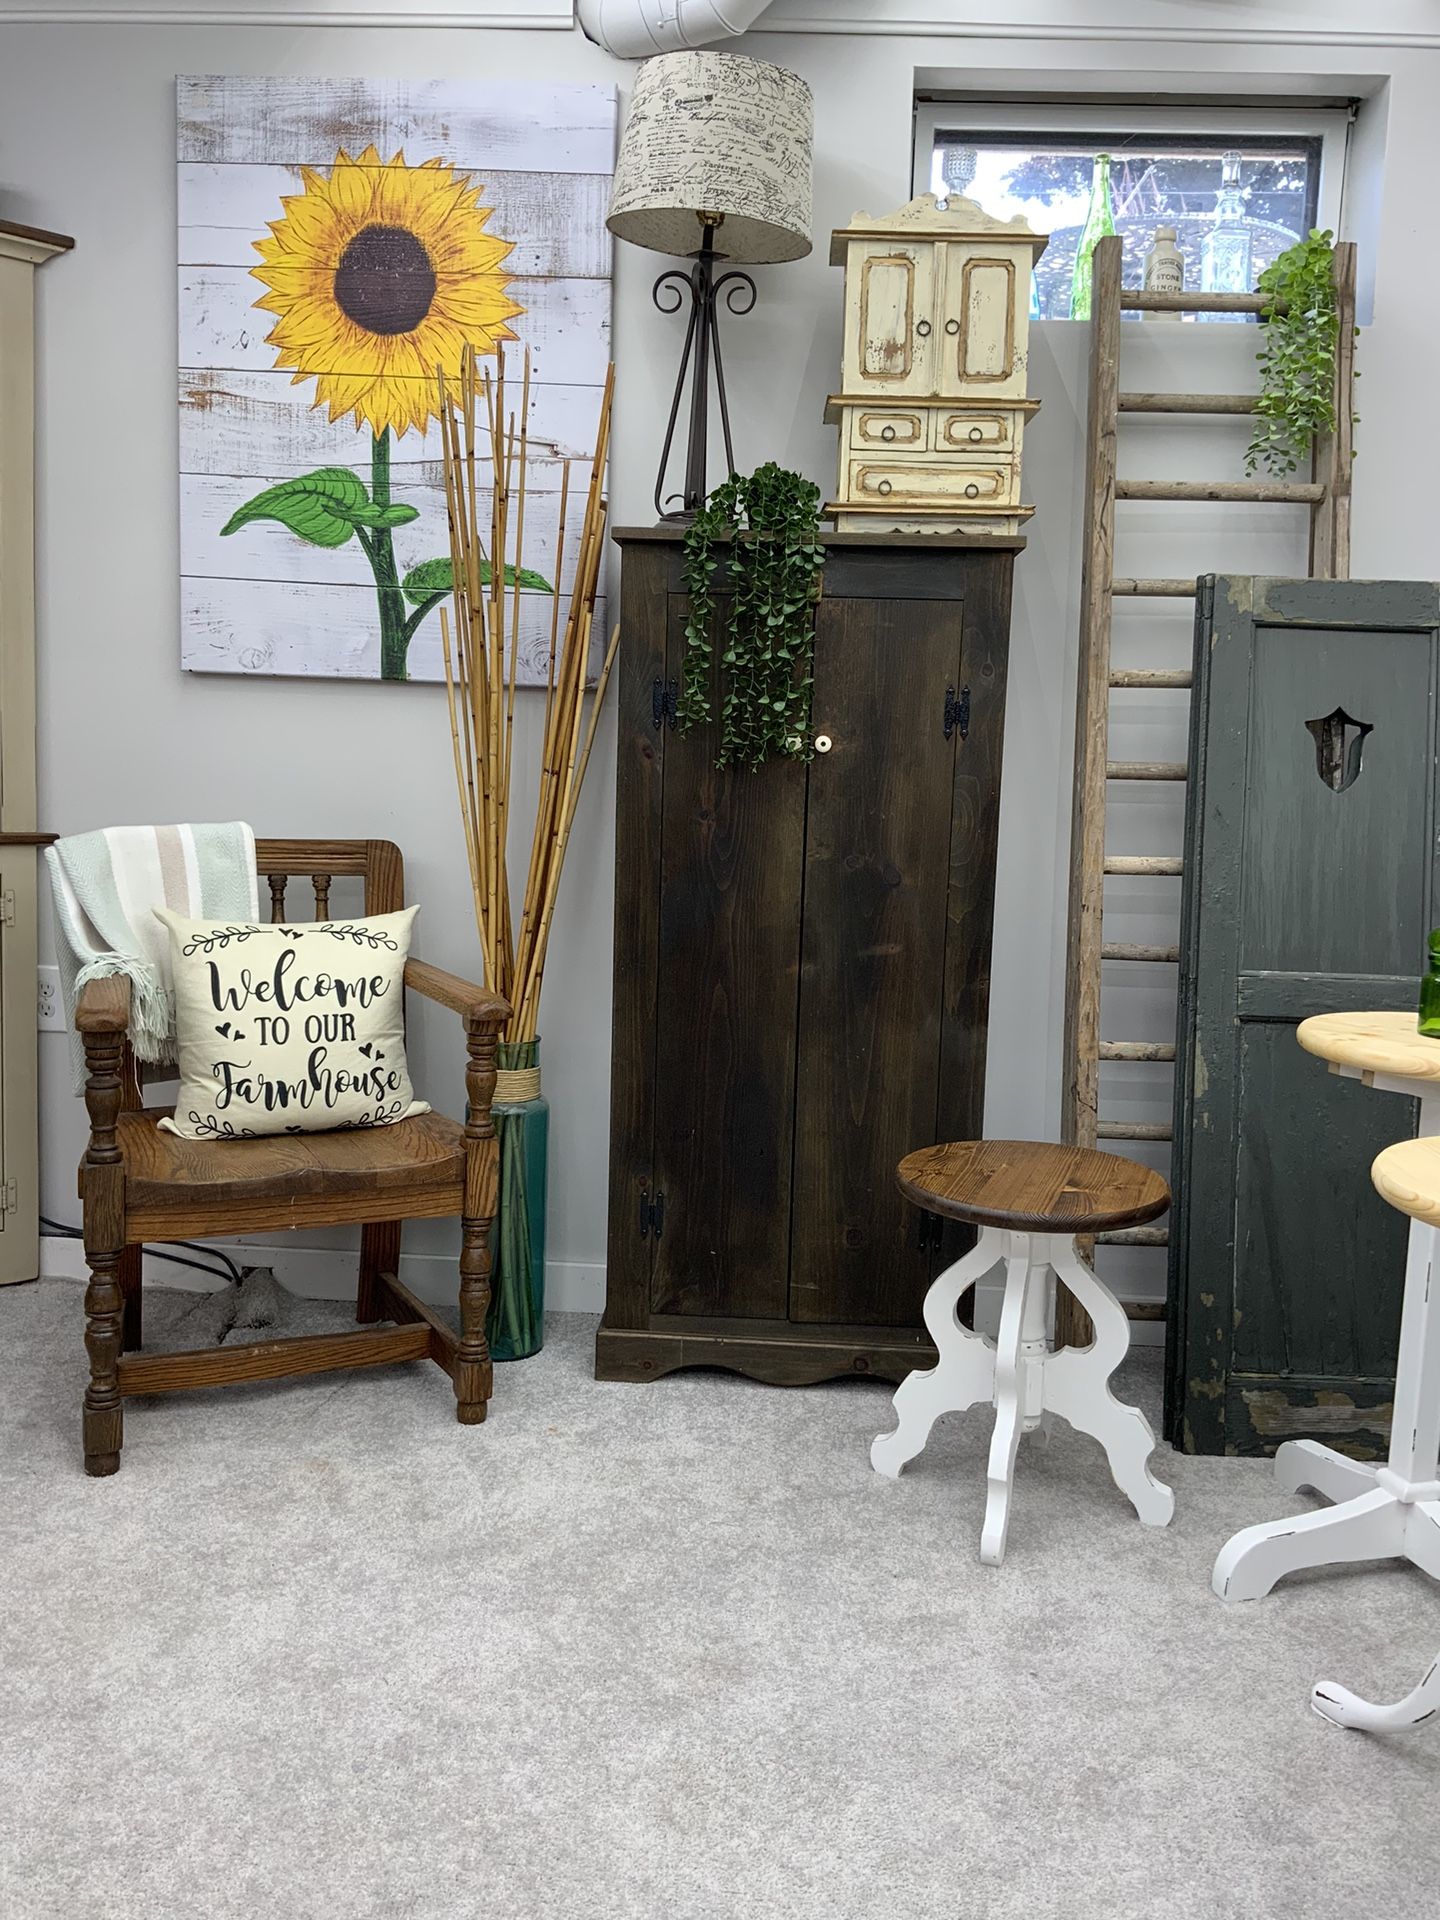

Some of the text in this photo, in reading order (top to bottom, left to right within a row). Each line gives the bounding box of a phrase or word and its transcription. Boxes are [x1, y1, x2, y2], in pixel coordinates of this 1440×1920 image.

[1157, 273, 1179, 281] STONE
[205, 949, 391, 1012] Welcome
[254, 1013, 356, 1046] TO OUR
[211, 1046, 401, 1112] Farmhouse
